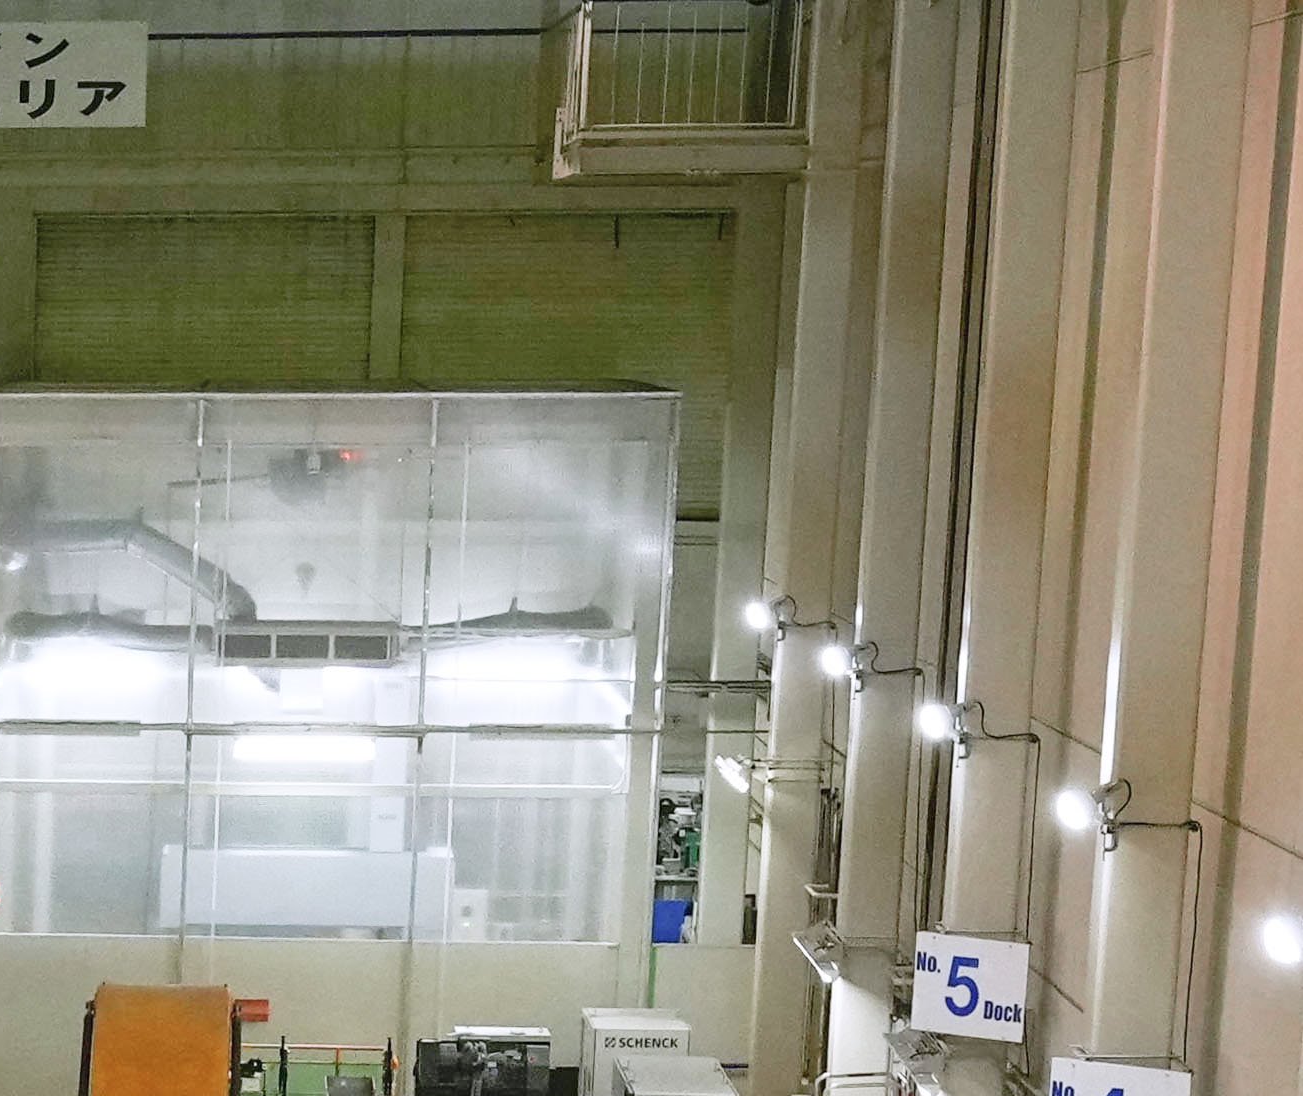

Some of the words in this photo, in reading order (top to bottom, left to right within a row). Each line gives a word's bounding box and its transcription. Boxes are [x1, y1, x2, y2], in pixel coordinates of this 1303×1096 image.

[916, 951, 941, 973] No.
[945, 955, 979, 1017] 5
[983, 1001, 1022, 1023] Dock
[618, 1037, 679, 1049] SCHENCK
